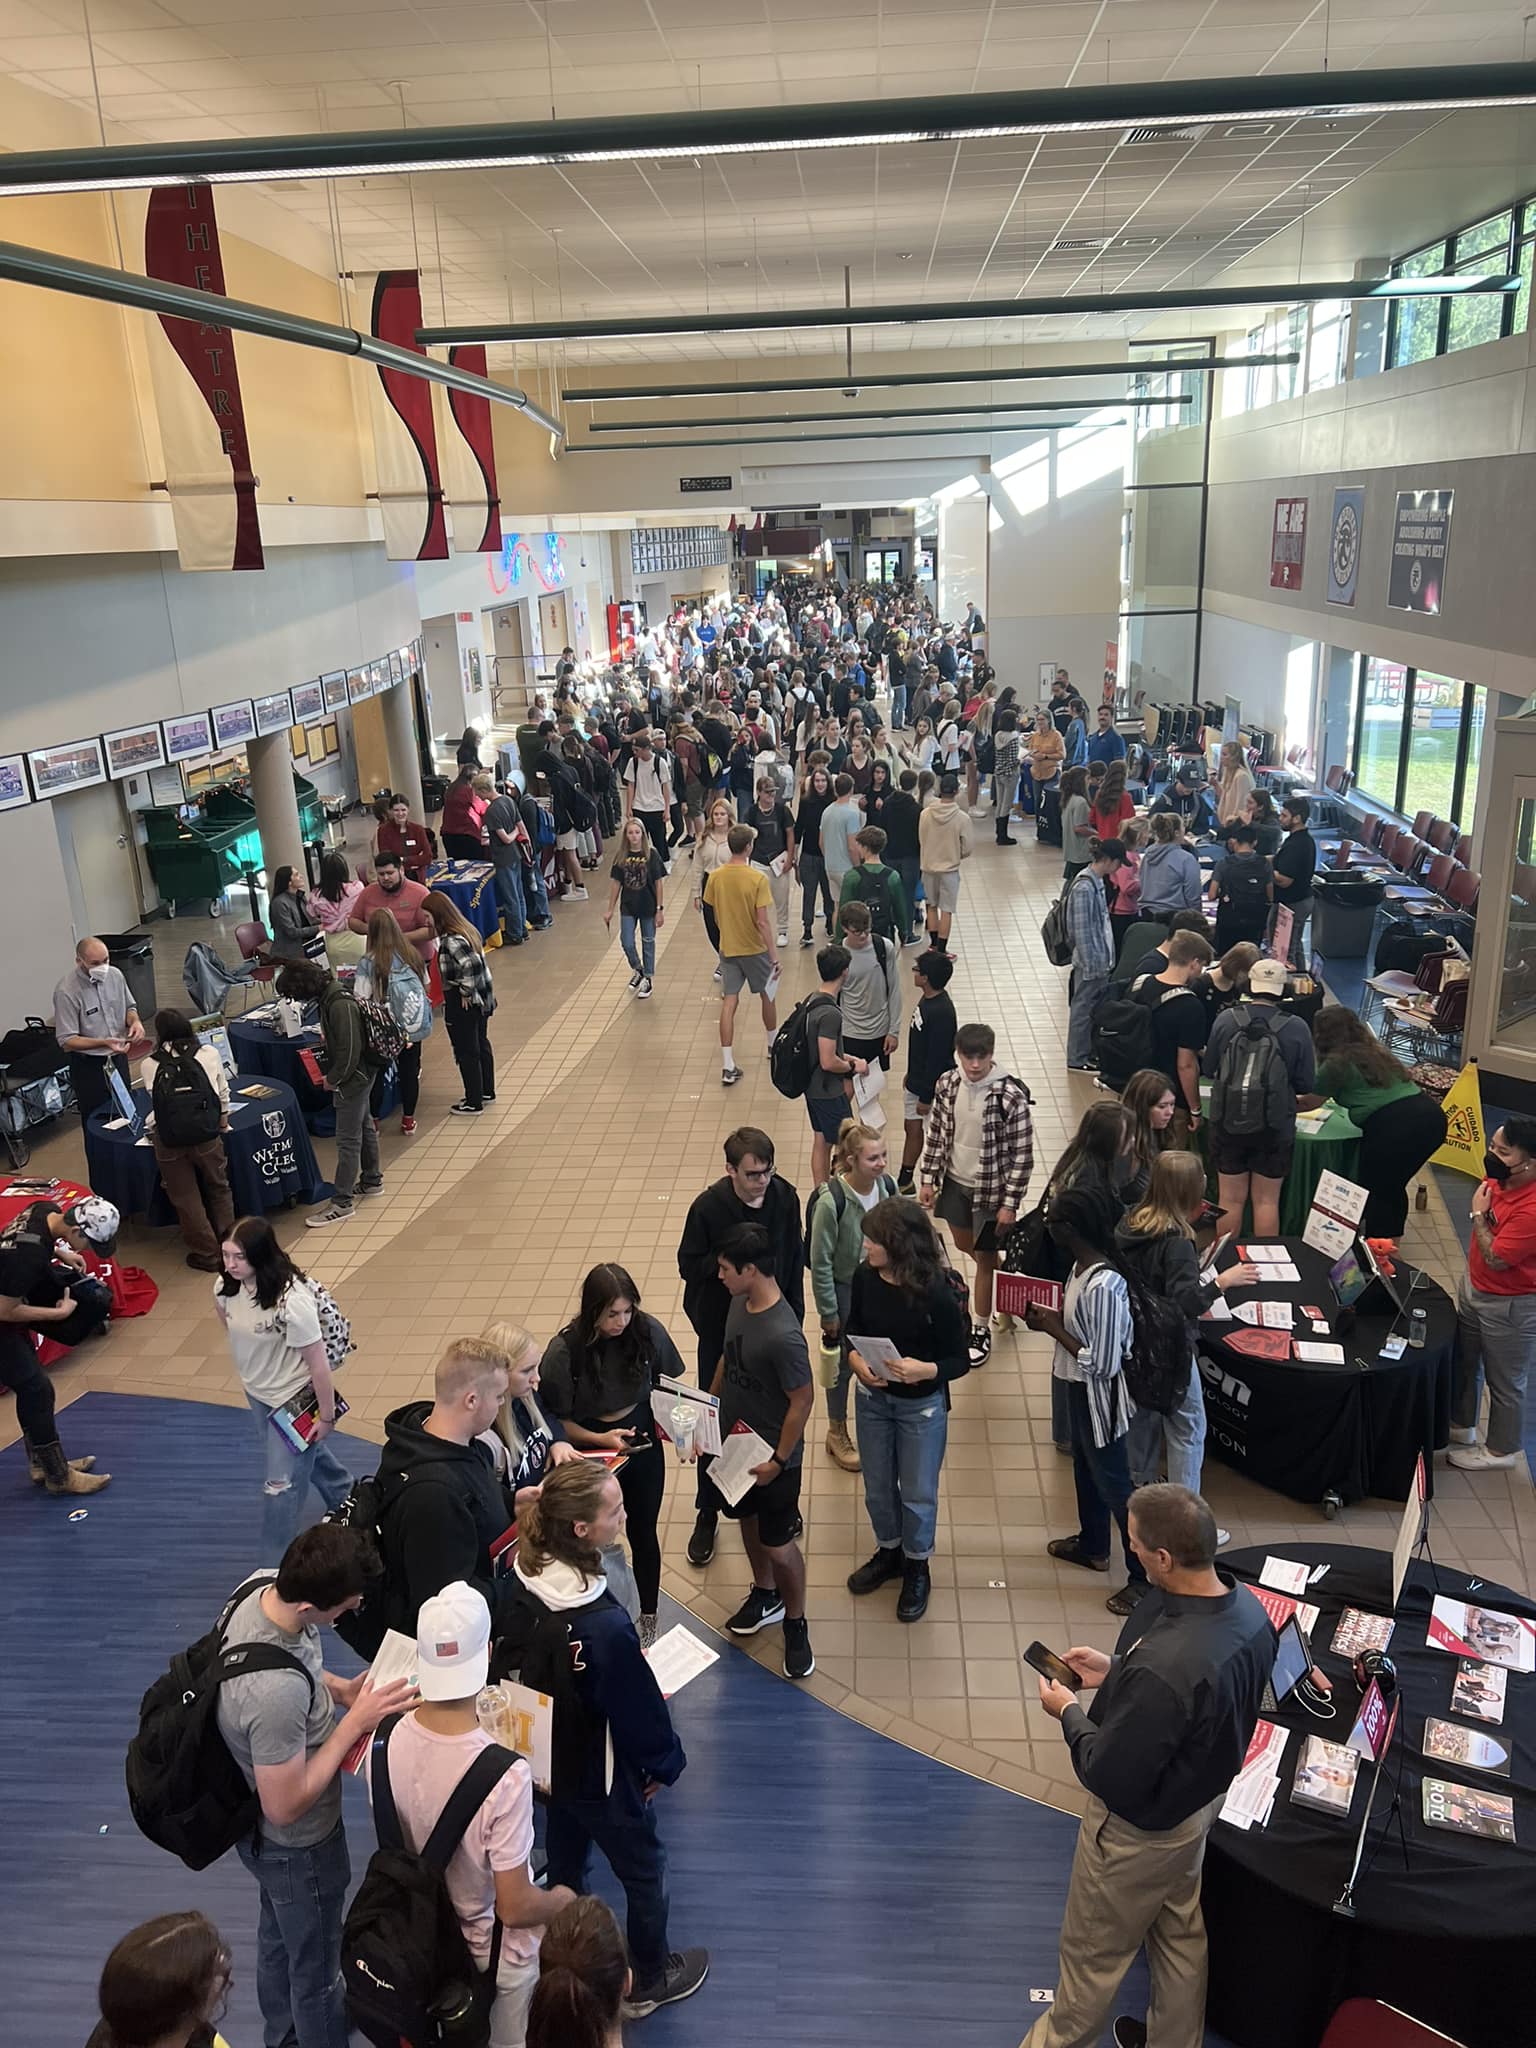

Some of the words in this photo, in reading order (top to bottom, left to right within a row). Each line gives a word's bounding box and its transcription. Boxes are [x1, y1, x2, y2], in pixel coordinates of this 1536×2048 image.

[1277, 503, 1290, 533] WE
[1289, 503, 1305, 533] ARE
[469, 877, 489, 909] Spokan
[1465, 1106, 1480, 1142] CUIDADO
[1336, 1608, 1359, 1650] ATHLETICS
[1366, 1695, 1383, 1738] 100%
[1038, 1990, 1047, 2000] 2
